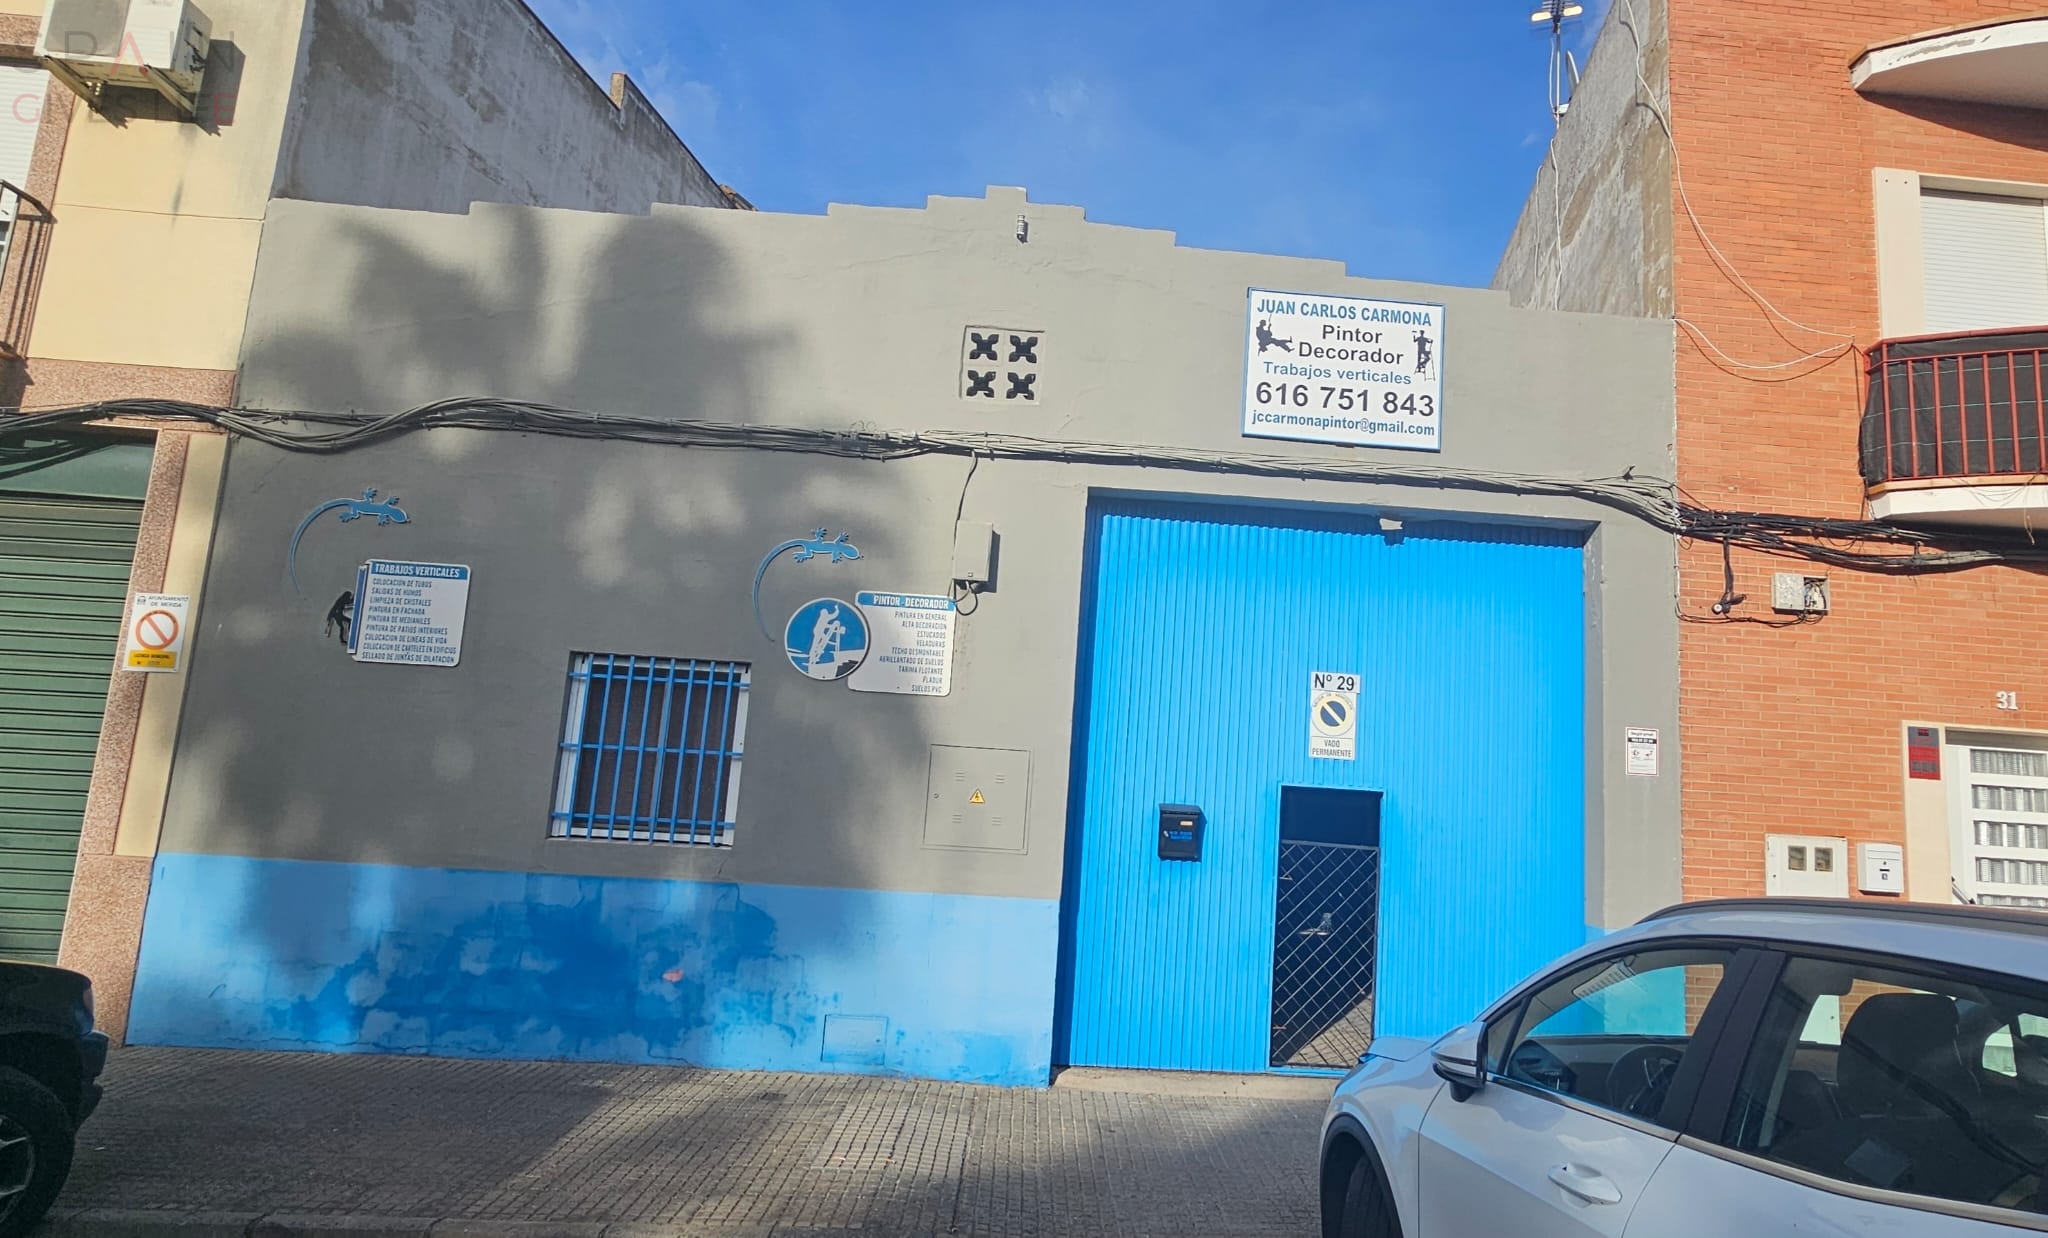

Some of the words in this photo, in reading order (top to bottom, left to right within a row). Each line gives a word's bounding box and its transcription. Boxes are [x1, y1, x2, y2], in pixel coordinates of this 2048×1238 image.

[1257, 299, 1296, 315] JUAN
[1300, 302, 1357, 318] CARLOS
[1361, 308, 1432, 326] CARMONA
[1322, 324, 1383, 344] Pintor
[1299, 341, 1404, 365] Decorador
[1264, 361, 1332, 380] Trabajos
[1337, 369, 1412, 385] verticales
[1256, 381, 1309, 407] 616
[1320, 386, 1369, 412] 751
[1382, 391, 1434, 417] 843
[1252, 410, 1435, 435] jccarmonapintor@gmail.com
[375, 564, 413, 575] TRABAJOS
[415, 567, 460, 578] VERTICALES
[873, 595, 900, 605] PINTOR
[905, 597, 949, 609] DECORADOR
[925, 613, 946, 621] GENERAL
[418, 627, 448, 635] INTERIORES
[917, 630, 945, 638] ESTUCADOS
[434, 647, 456, 655] EDIFICIOS
[918, 667, 942, 675] FLOTANTE
[922, 676, 942, 684] PLADUR
[1337, 675, 1354, 691] 29
[911, 684, 930, 692] SUELOS
[1997, 691, 2018, 710] 31
[1312, 748, 1352, 757] PERMANENTE
